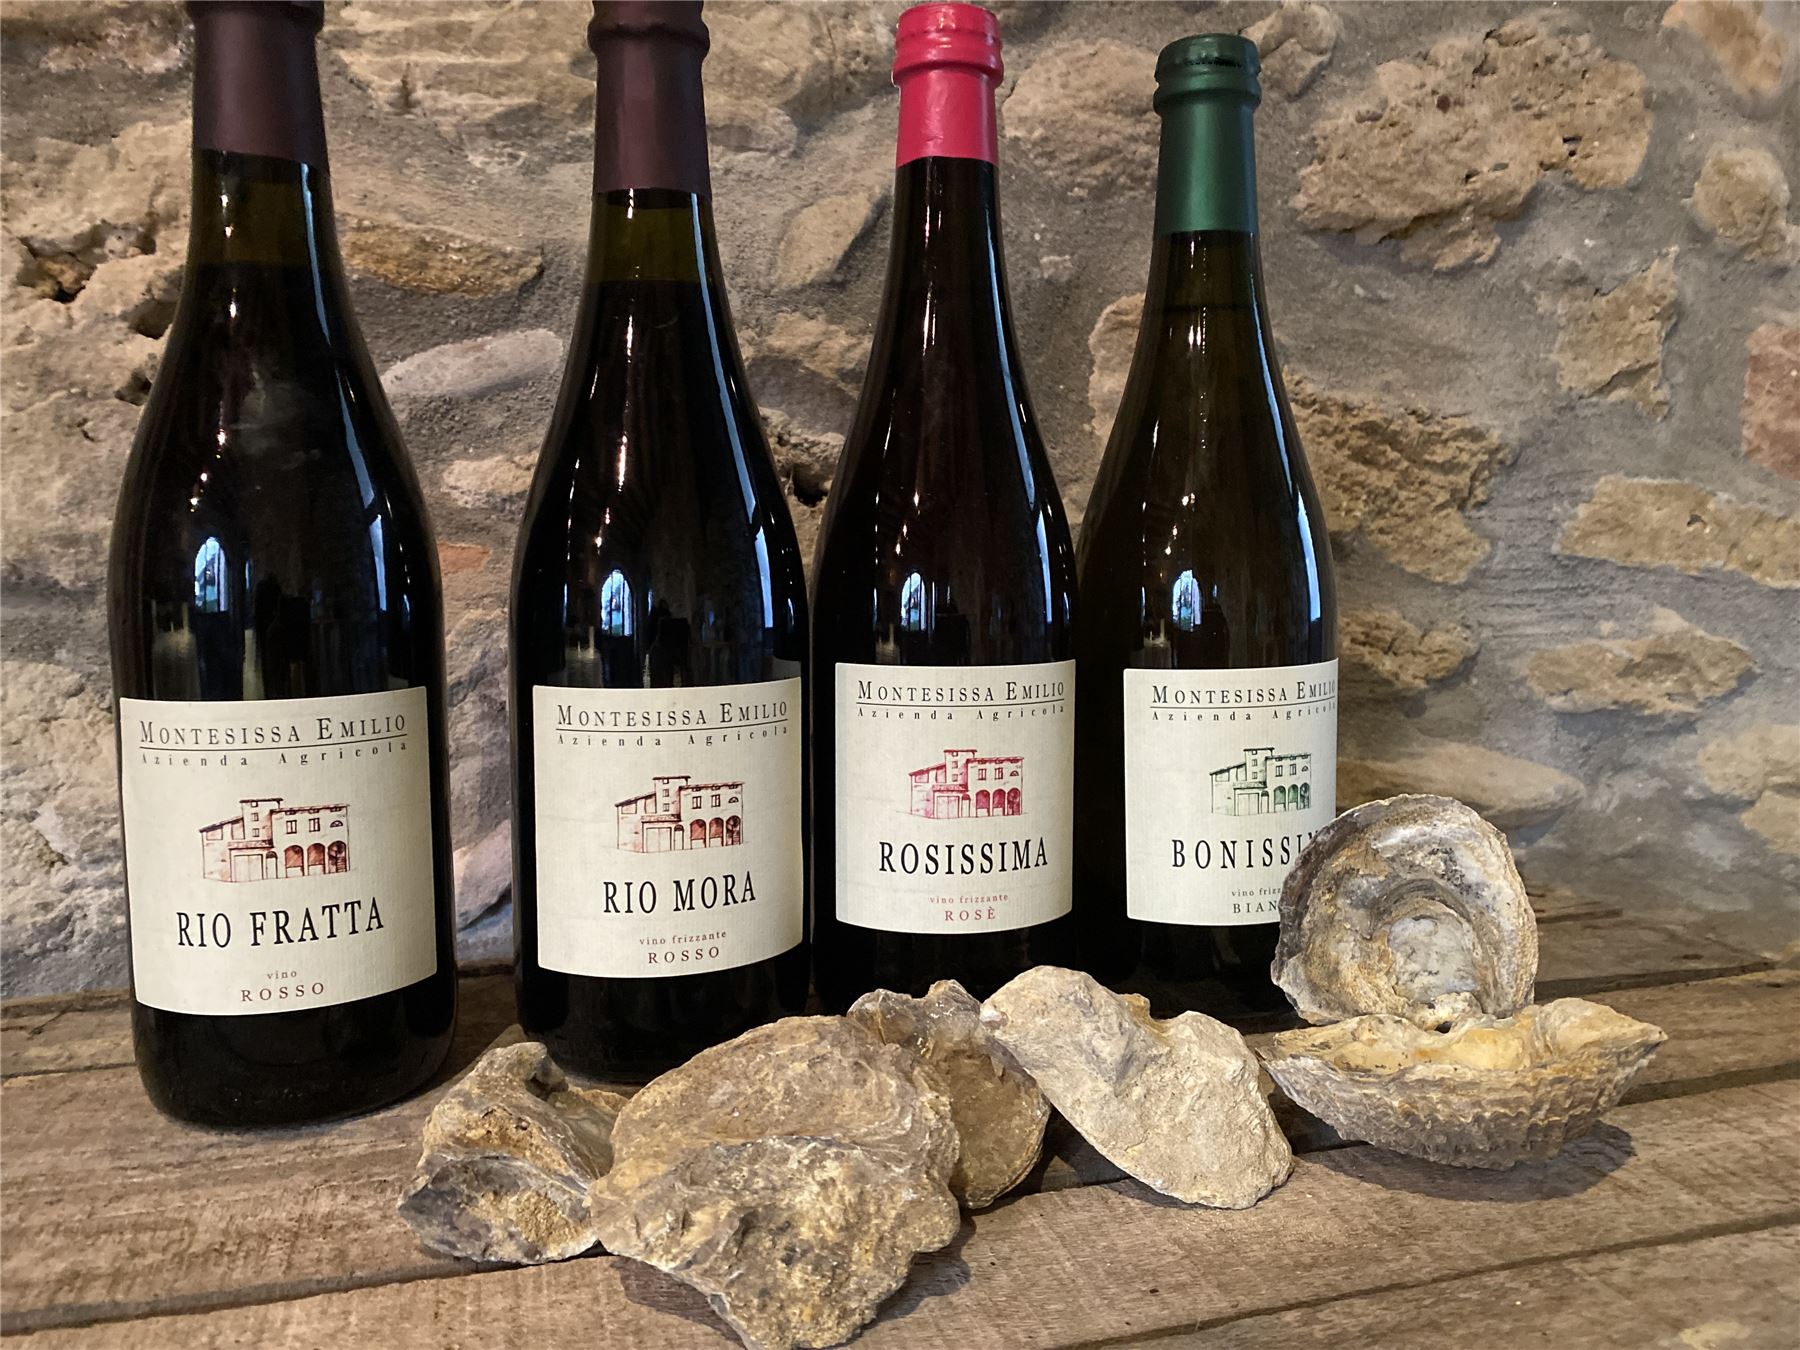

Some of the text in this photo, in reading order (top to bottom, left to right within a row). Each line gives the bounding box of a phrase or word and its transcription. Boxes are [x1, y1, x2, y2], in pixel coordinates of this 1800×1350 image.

[857, 703, 1064, 721] Azienda Agricola
[1152, 710, 1251, 721] Azienda
[558, 725, 787, 747] Azienda Agricola
[141, 741, 407, 767] Azienda Agricola
[878, 836, 1048, 875] ROSISSIMA
[1171, 830, 1318, 869] BONISSI
[602, 870, 756, 914] RIO MORA
[929, 893, 1009, 904] vino frizzante
[1231, 887, 1281, 897] vino frizz
[944, 906, 996, 921] ROSÈ
[1232, 900, 1278, 914] BIAN
[176, 896, 384, 949] RIO FRATTA
[639, 930, 727, 946] vino frizzante
[648, 946, 720, 964] ROSSO
[266, 969, 297, 980] vino
[241, 982, 325, 1002] ROSSO
